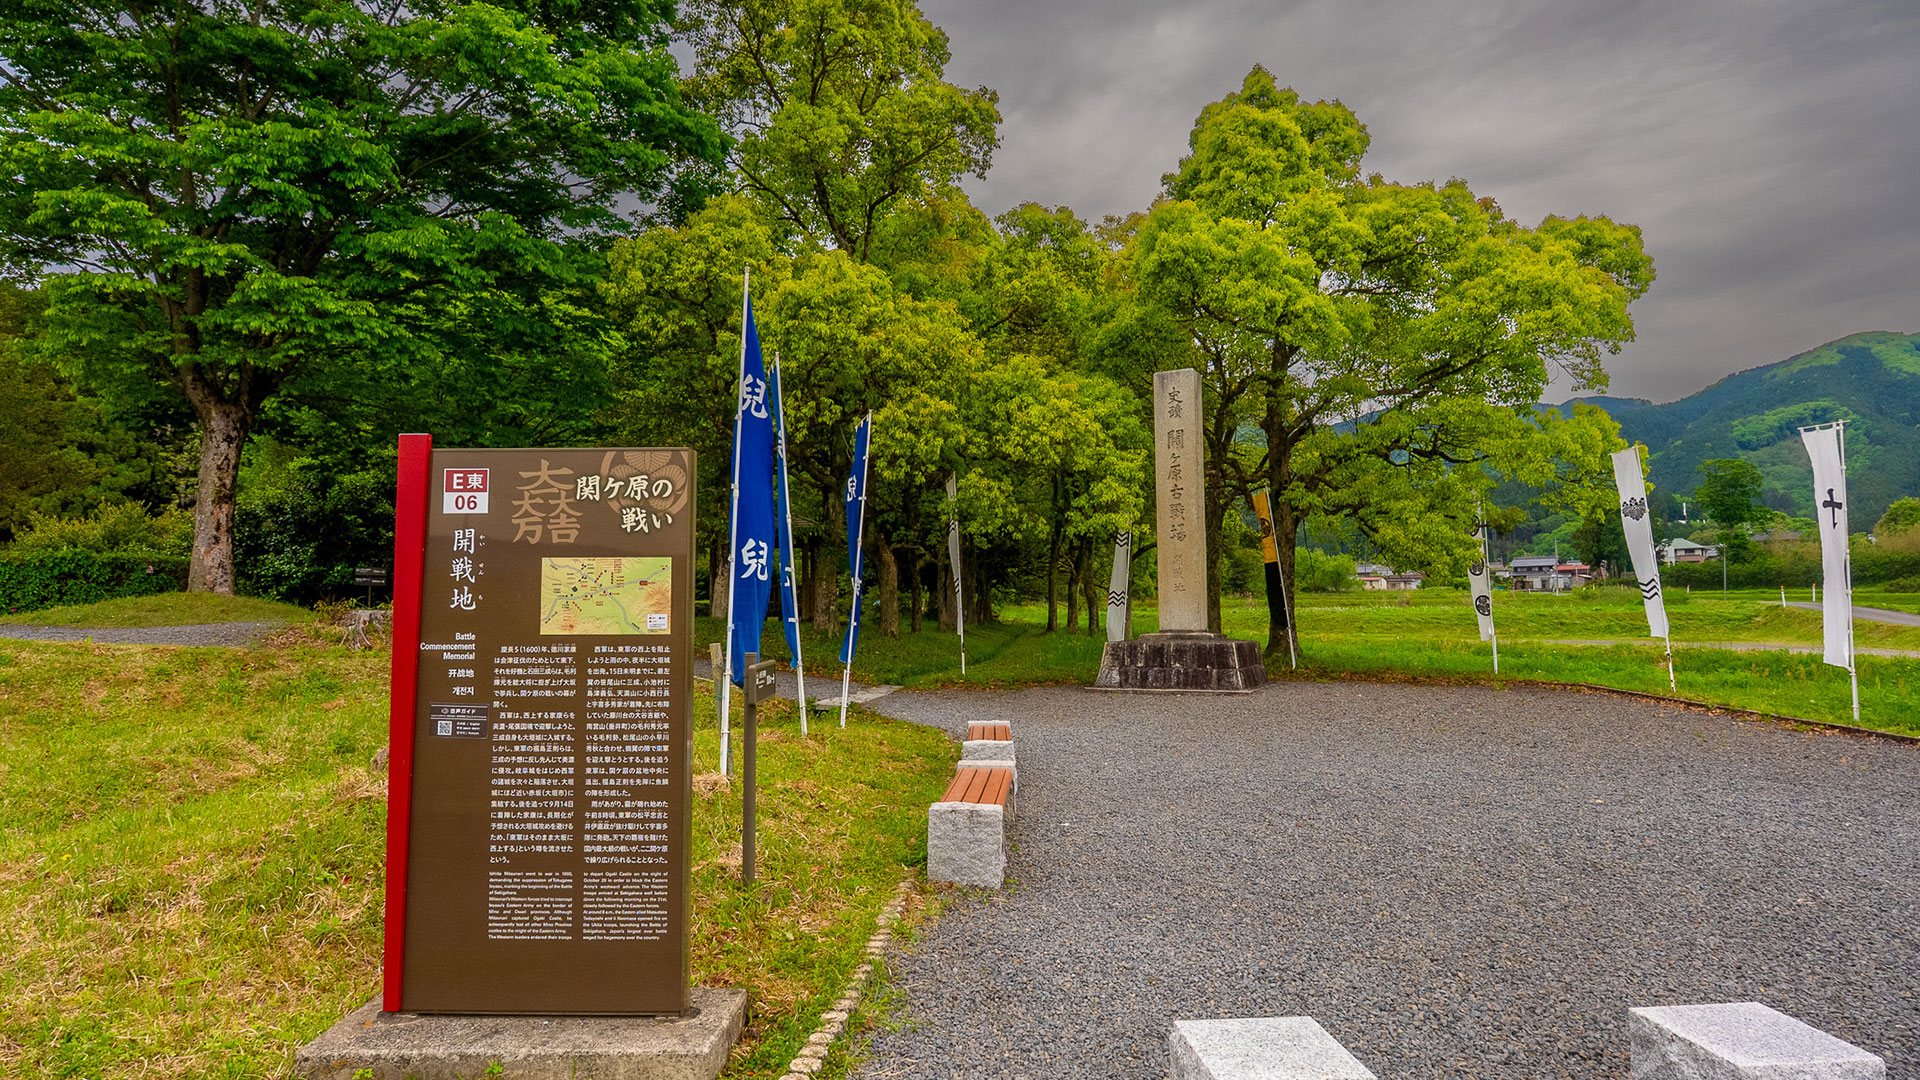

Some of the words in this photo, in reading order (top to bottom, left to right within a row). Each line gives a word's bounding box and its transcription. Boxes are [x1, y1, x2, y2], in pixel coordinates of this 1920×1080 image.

[452, 472, 484, 490] E東
[454, 495, 478, 510] 06
[620, 507, 673, 534] 戦い
[450, 528, 476, 610] 開戦地
[455, 632, 476, 640] Battle
[420, 642, 476, 650] Commencement
[443, 652, 476, 660] Memorial
[448, 668, 474, 678] 开战地
[452, 686, 474, 696] 개전지
